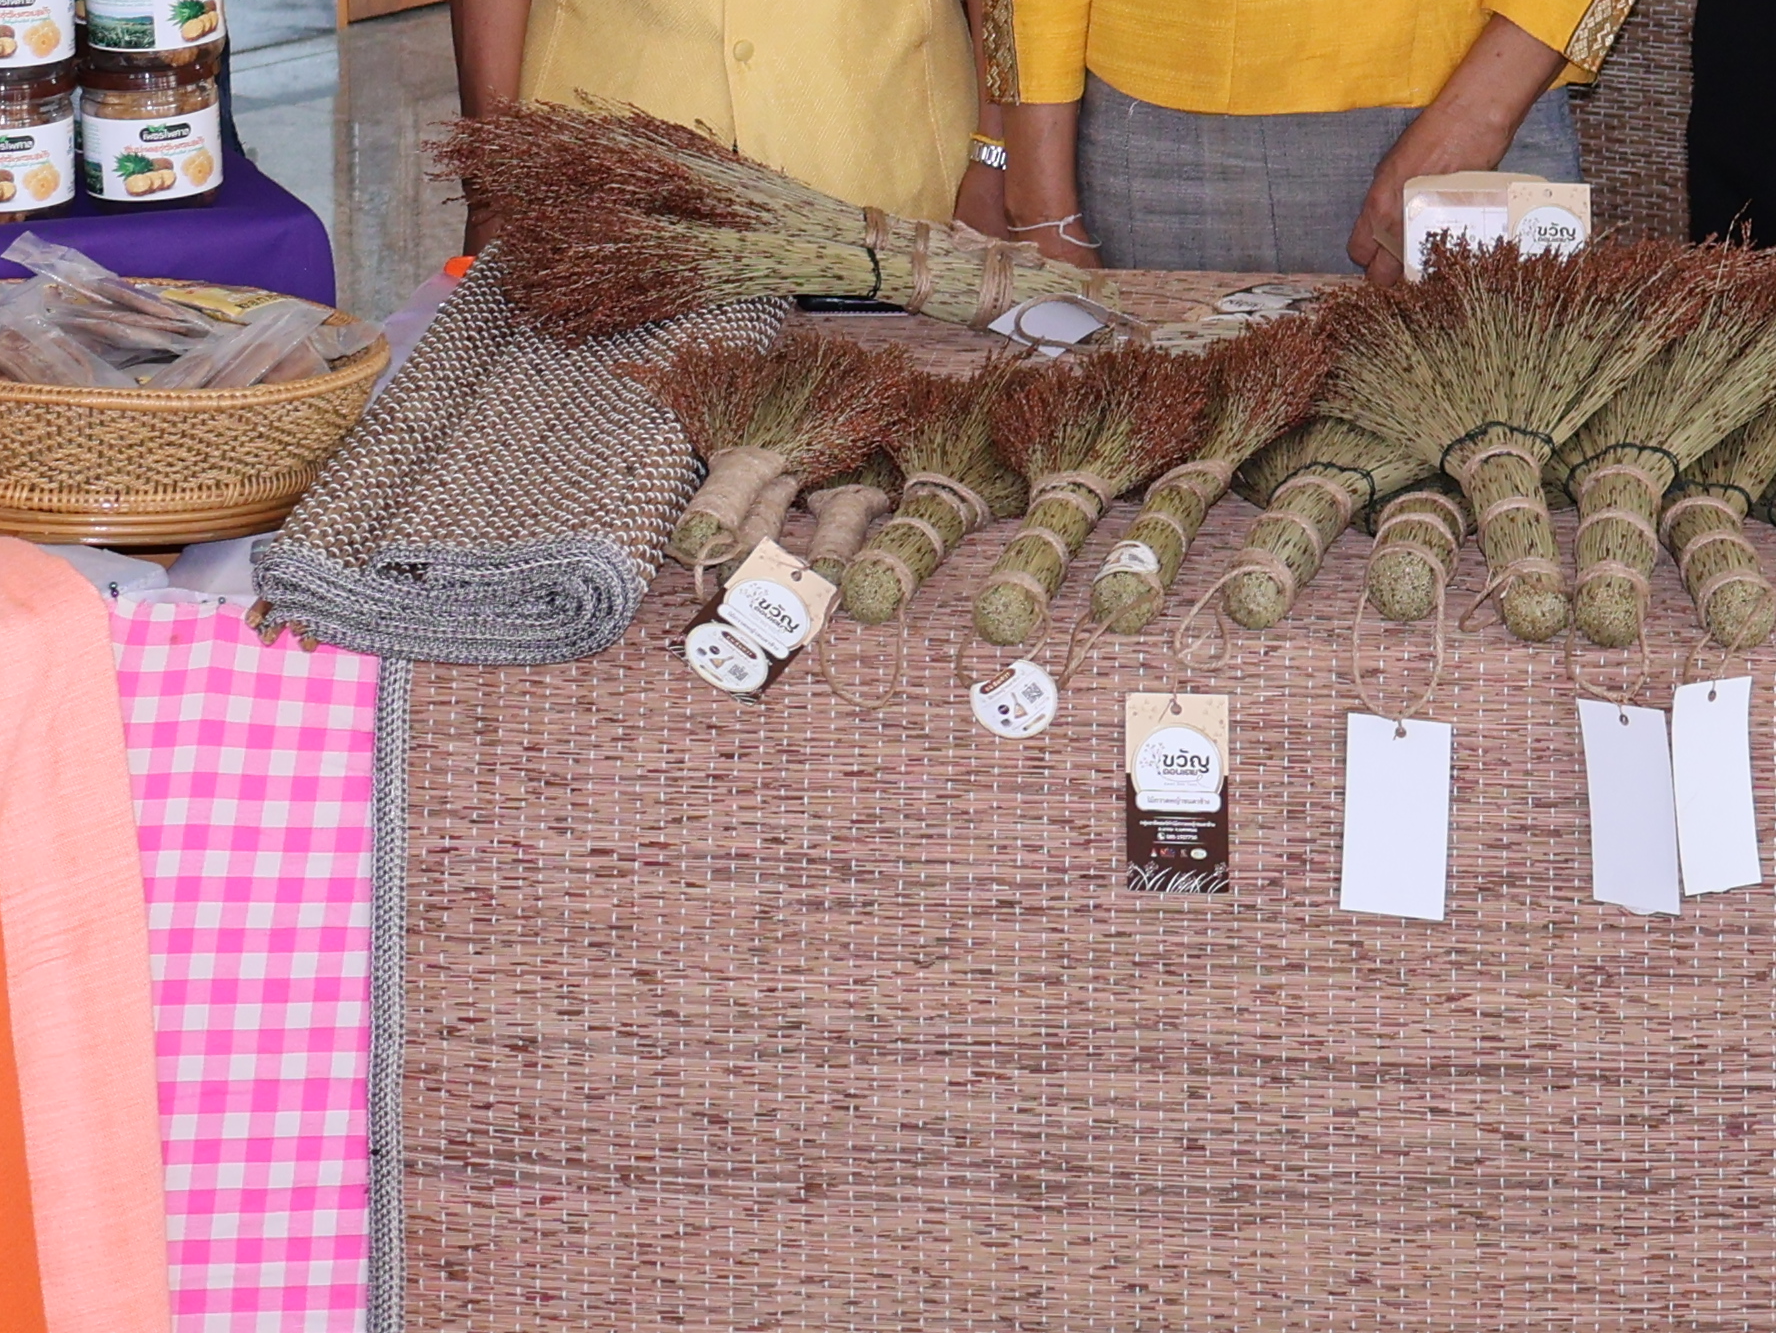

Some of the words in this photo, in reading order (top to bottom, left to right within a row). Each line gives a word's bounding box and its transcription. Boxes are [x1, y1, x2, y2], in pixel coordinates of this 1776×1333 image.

[1537, 221, 1577, 242] ขวัญ
[758, 596, 801, 635] ขวัญ
[1162, 747, 1211, 775] ขวัญ
